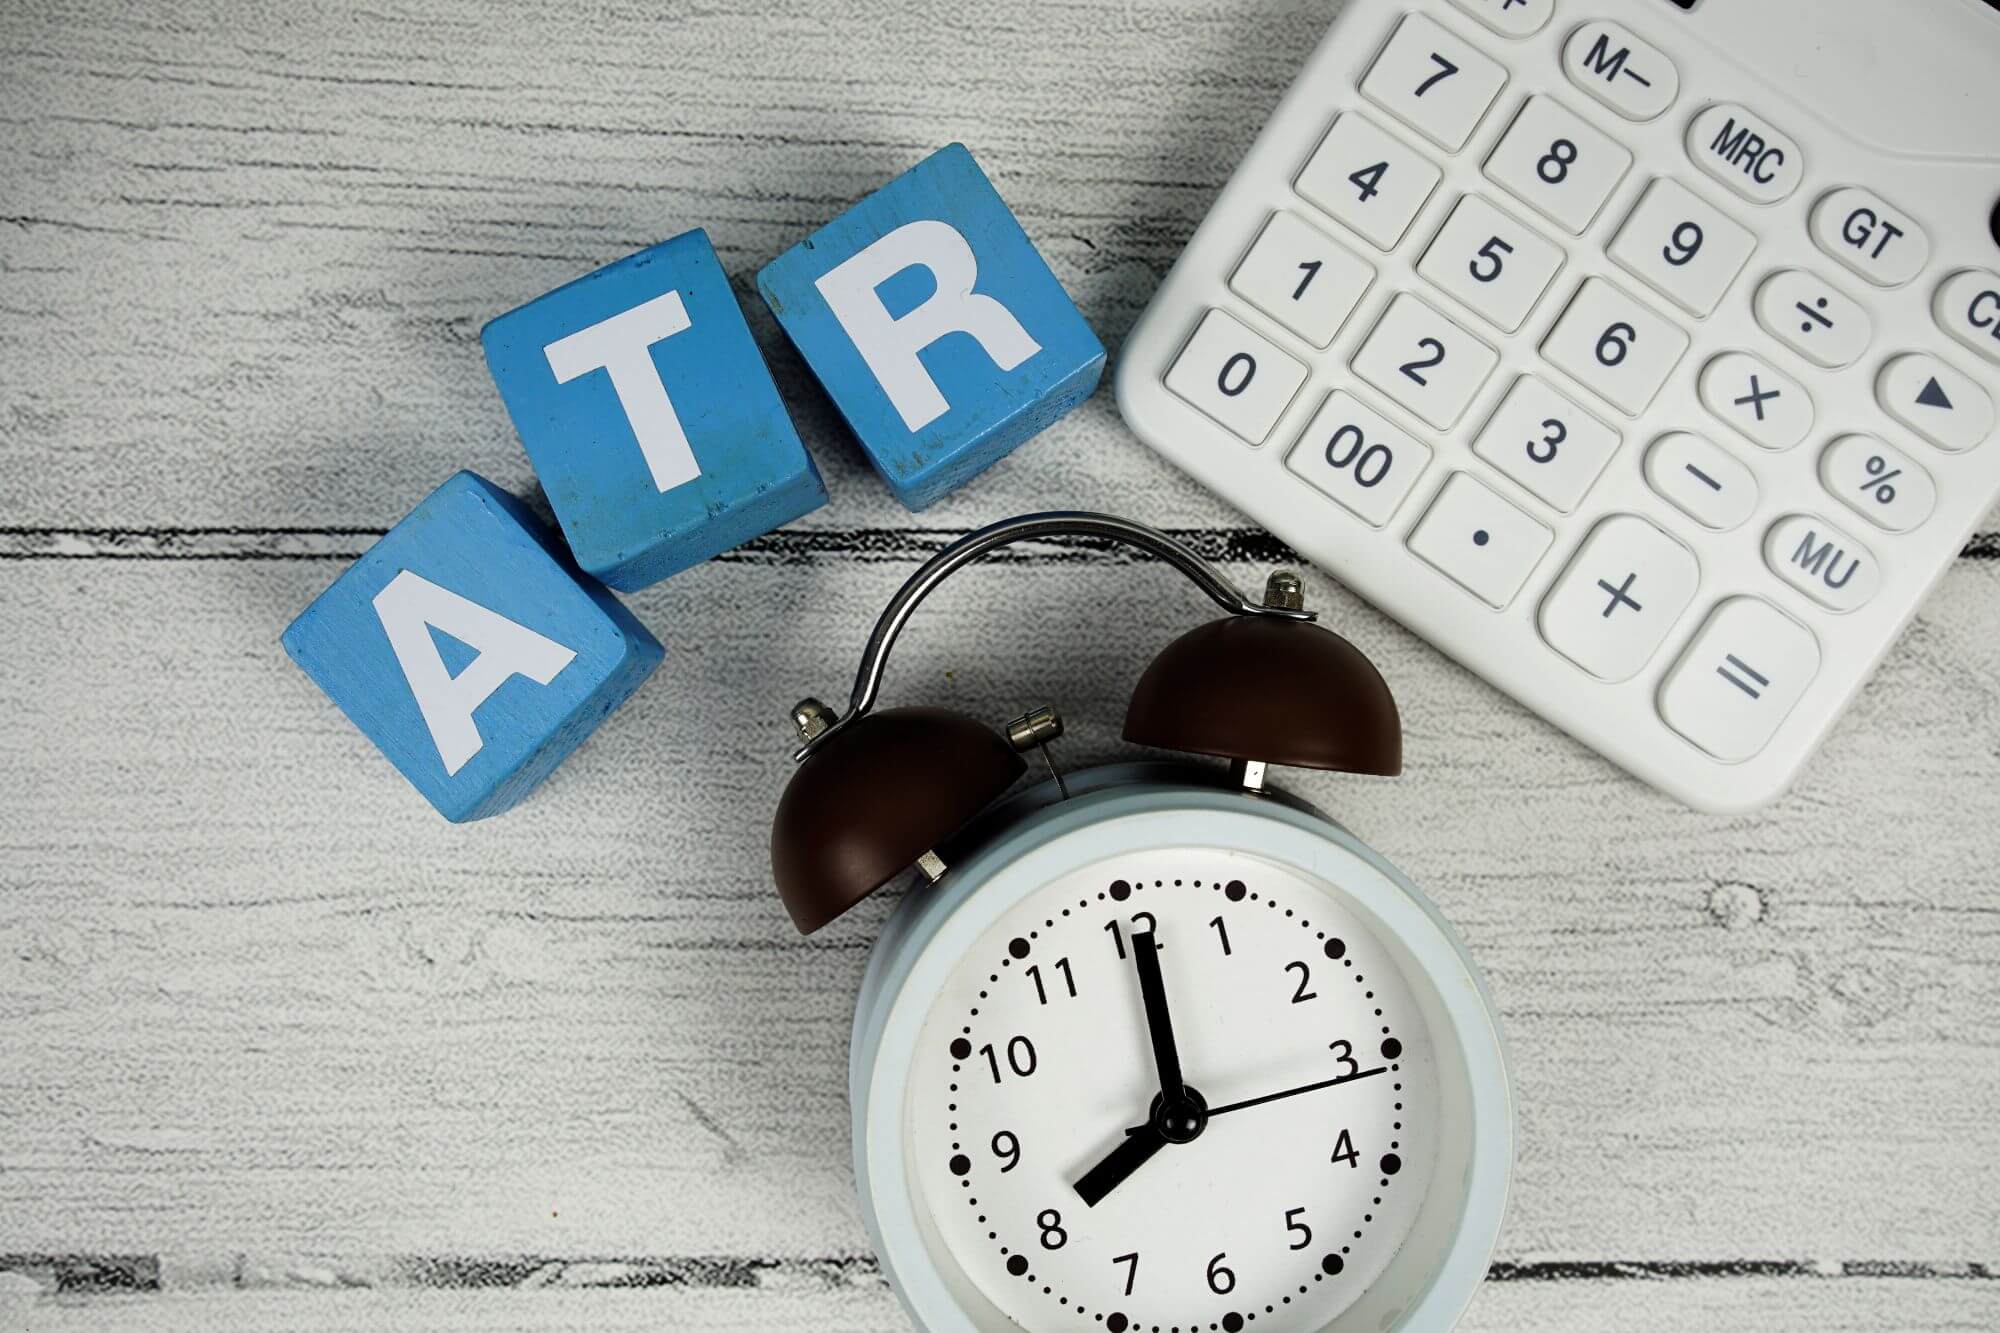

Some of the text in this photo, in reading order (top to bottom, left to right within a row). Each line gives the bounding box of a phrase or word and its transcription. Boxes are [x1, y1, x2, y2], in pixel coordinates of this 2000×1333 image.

[1415, 53, 1459, 97] 7
[1537, 139, 1577, 184] 8
[1710, 118, 1784, 184] MRC
[1349, 162, 1389, 202] 4
[1663, 222, 1703, 266] 9
[1843, 208, 1903, 259] GT
[1470, 236, 1513, 282] 5
[1292, 261, 1322, 301] 1
[1399, 338, 1445, 386] 2
[1596, 323, 1635, 366] 6
[1218, 353, 1256, 396] 0
[1326, 425, 1392, 487] 00
[1527, 419, 1566, 463] 3
[1792, 532, 1859, 588] MU
[1210, 916, 1231, 955] 1
[1026, 958, 1077, 1004] 11
[1285, 961, 1317, 1003] 2
[980, 1036, 1037, 1083] 10
[1329, 1039, 1359, 1080] 3
[991, 1131, 1020, 1173] 9
[1331, 1129, 1360, 1168] 4
[1037, 1209, 1067, 1250] 8
[1286, 1207, 1312, 1250] 5
[1113, 1253, 1138, 1296] 7
[1207, 1253, 1235, 1294] 6
